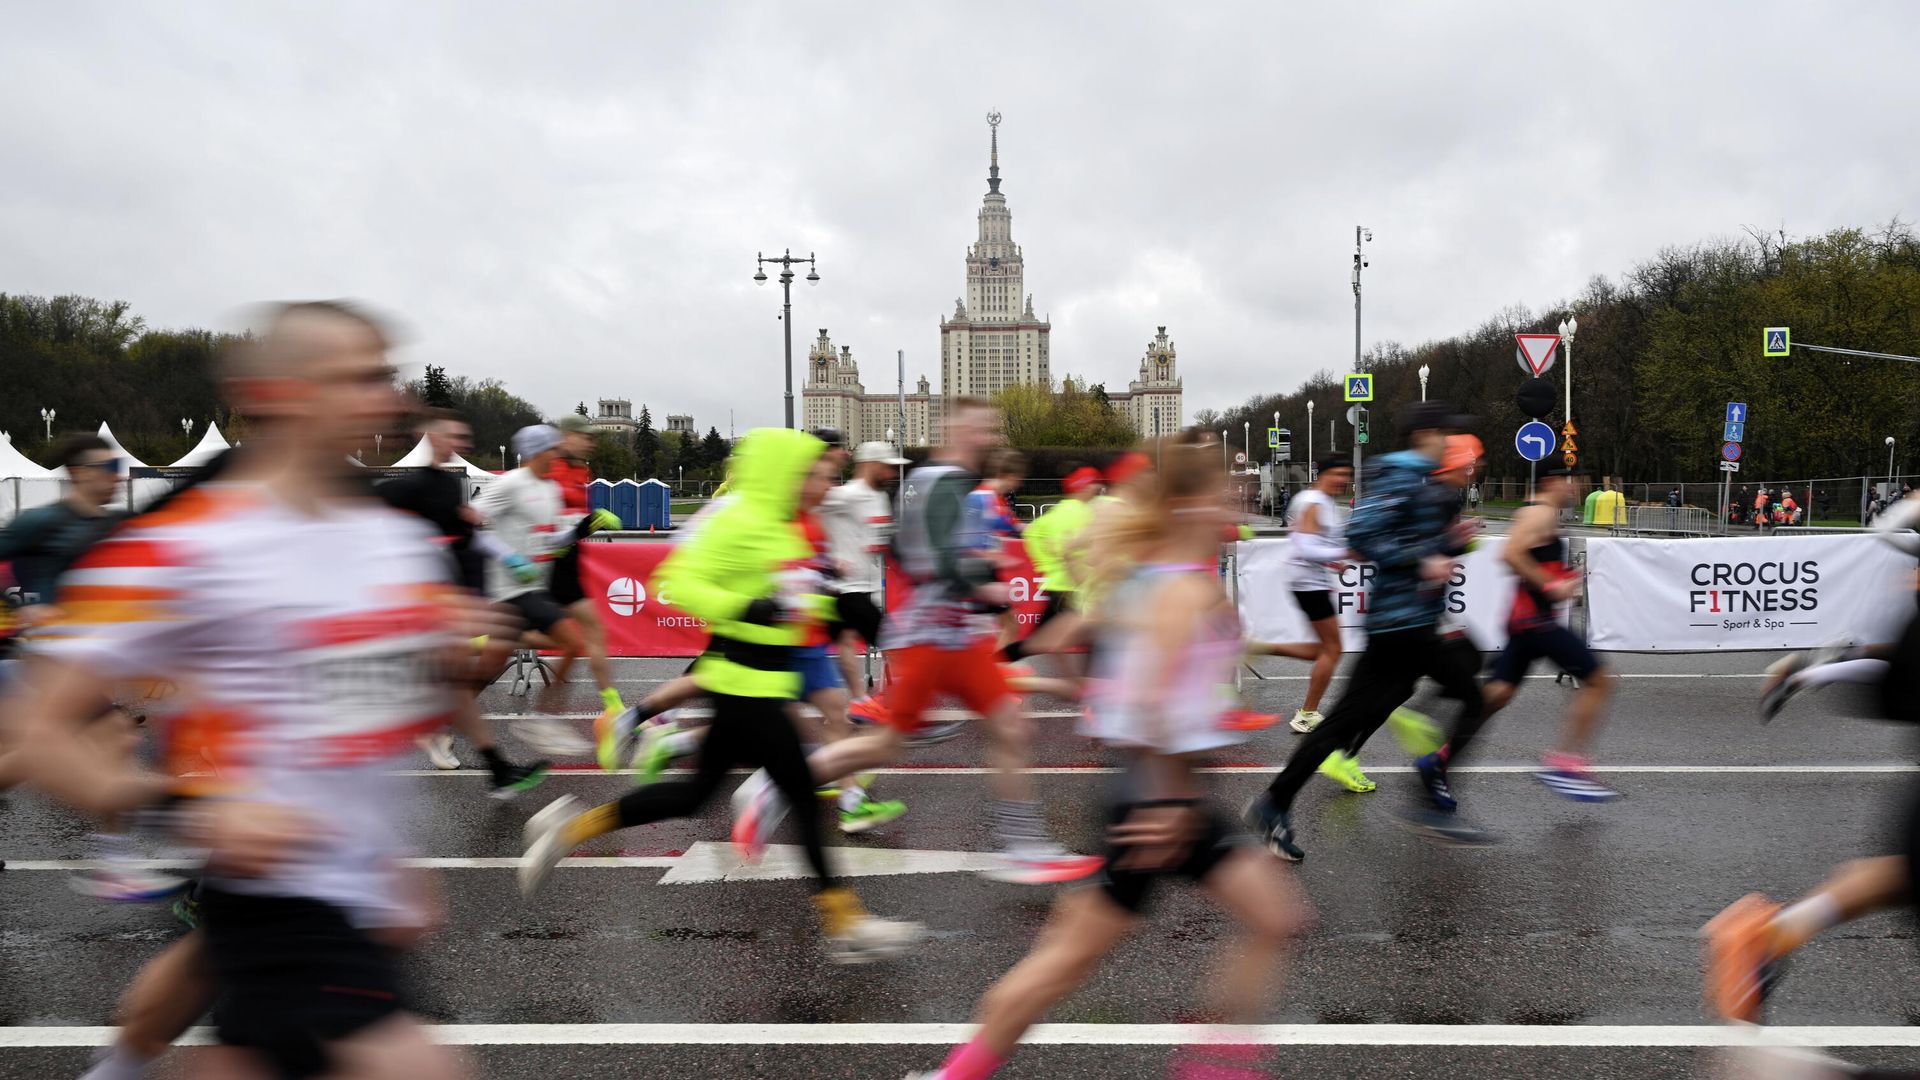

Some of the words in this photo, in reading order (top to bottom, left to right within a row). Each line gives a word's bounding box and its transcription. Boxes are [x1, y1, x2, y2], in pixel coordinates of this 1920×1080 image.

[1338, 563, 1467, 587] CRS
[1690, 561, 1820, 586] CROCUS
[657, 616, 708, 627] HOTELS
[1722, 619, 1750, 631] Sport
[1752, 619, 1761, 628] &
[1764, 618, 1785, 630] Spa
